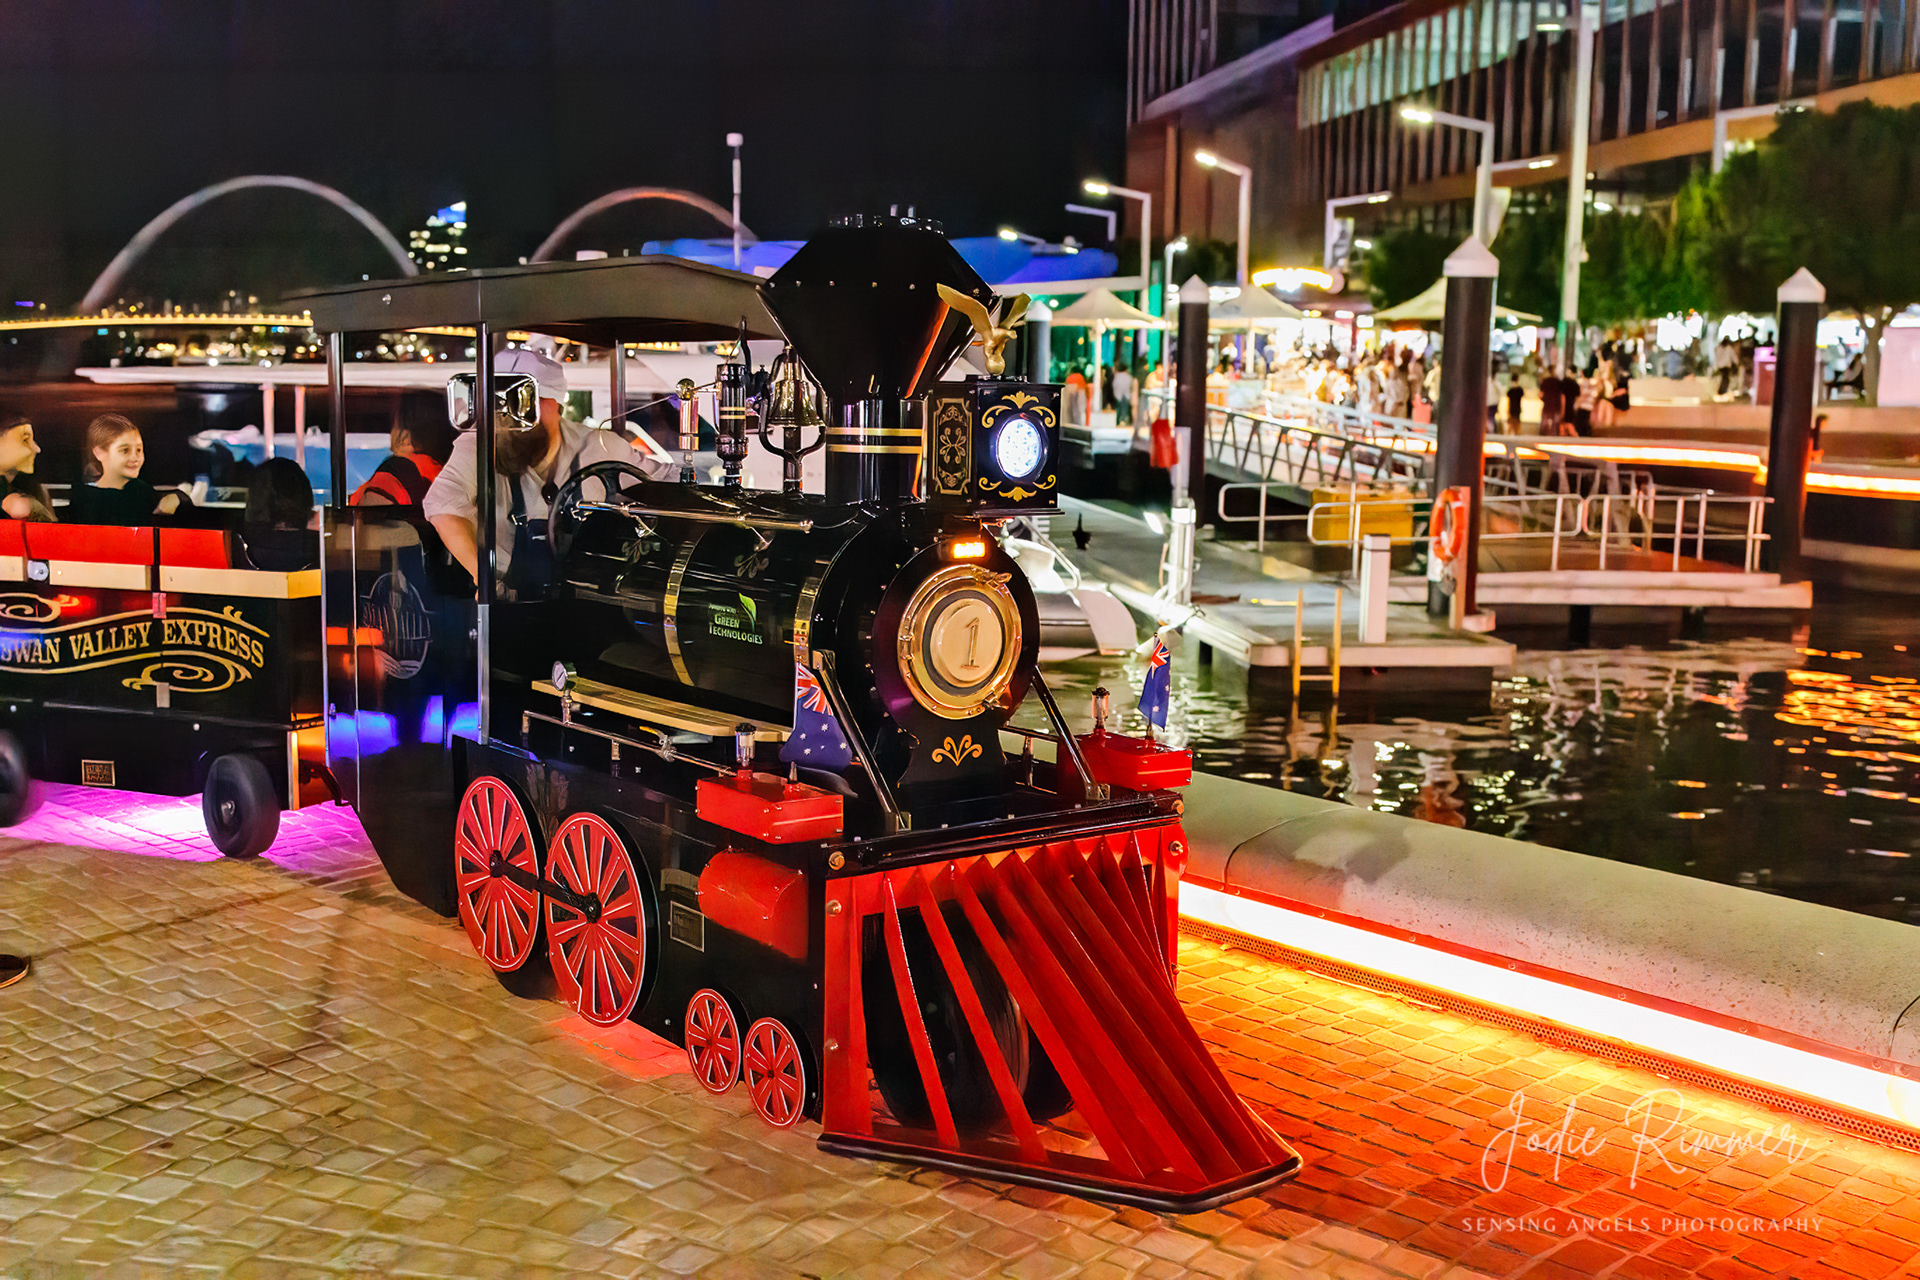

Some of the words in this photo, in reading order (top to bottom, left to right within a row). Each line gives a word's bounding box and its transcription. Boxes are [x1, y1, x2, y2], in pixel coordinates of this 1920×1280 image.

[708, 622, 763, 645] TECHNOLOGIES
[714, 612, 740, 628] GREEN
[1, 637, 61, 664] SWAN
[69, 621, 152, 660] VALLEY
[162, 619, 264, 668] EXPRESS
[960, 617, 980, 670] 1
